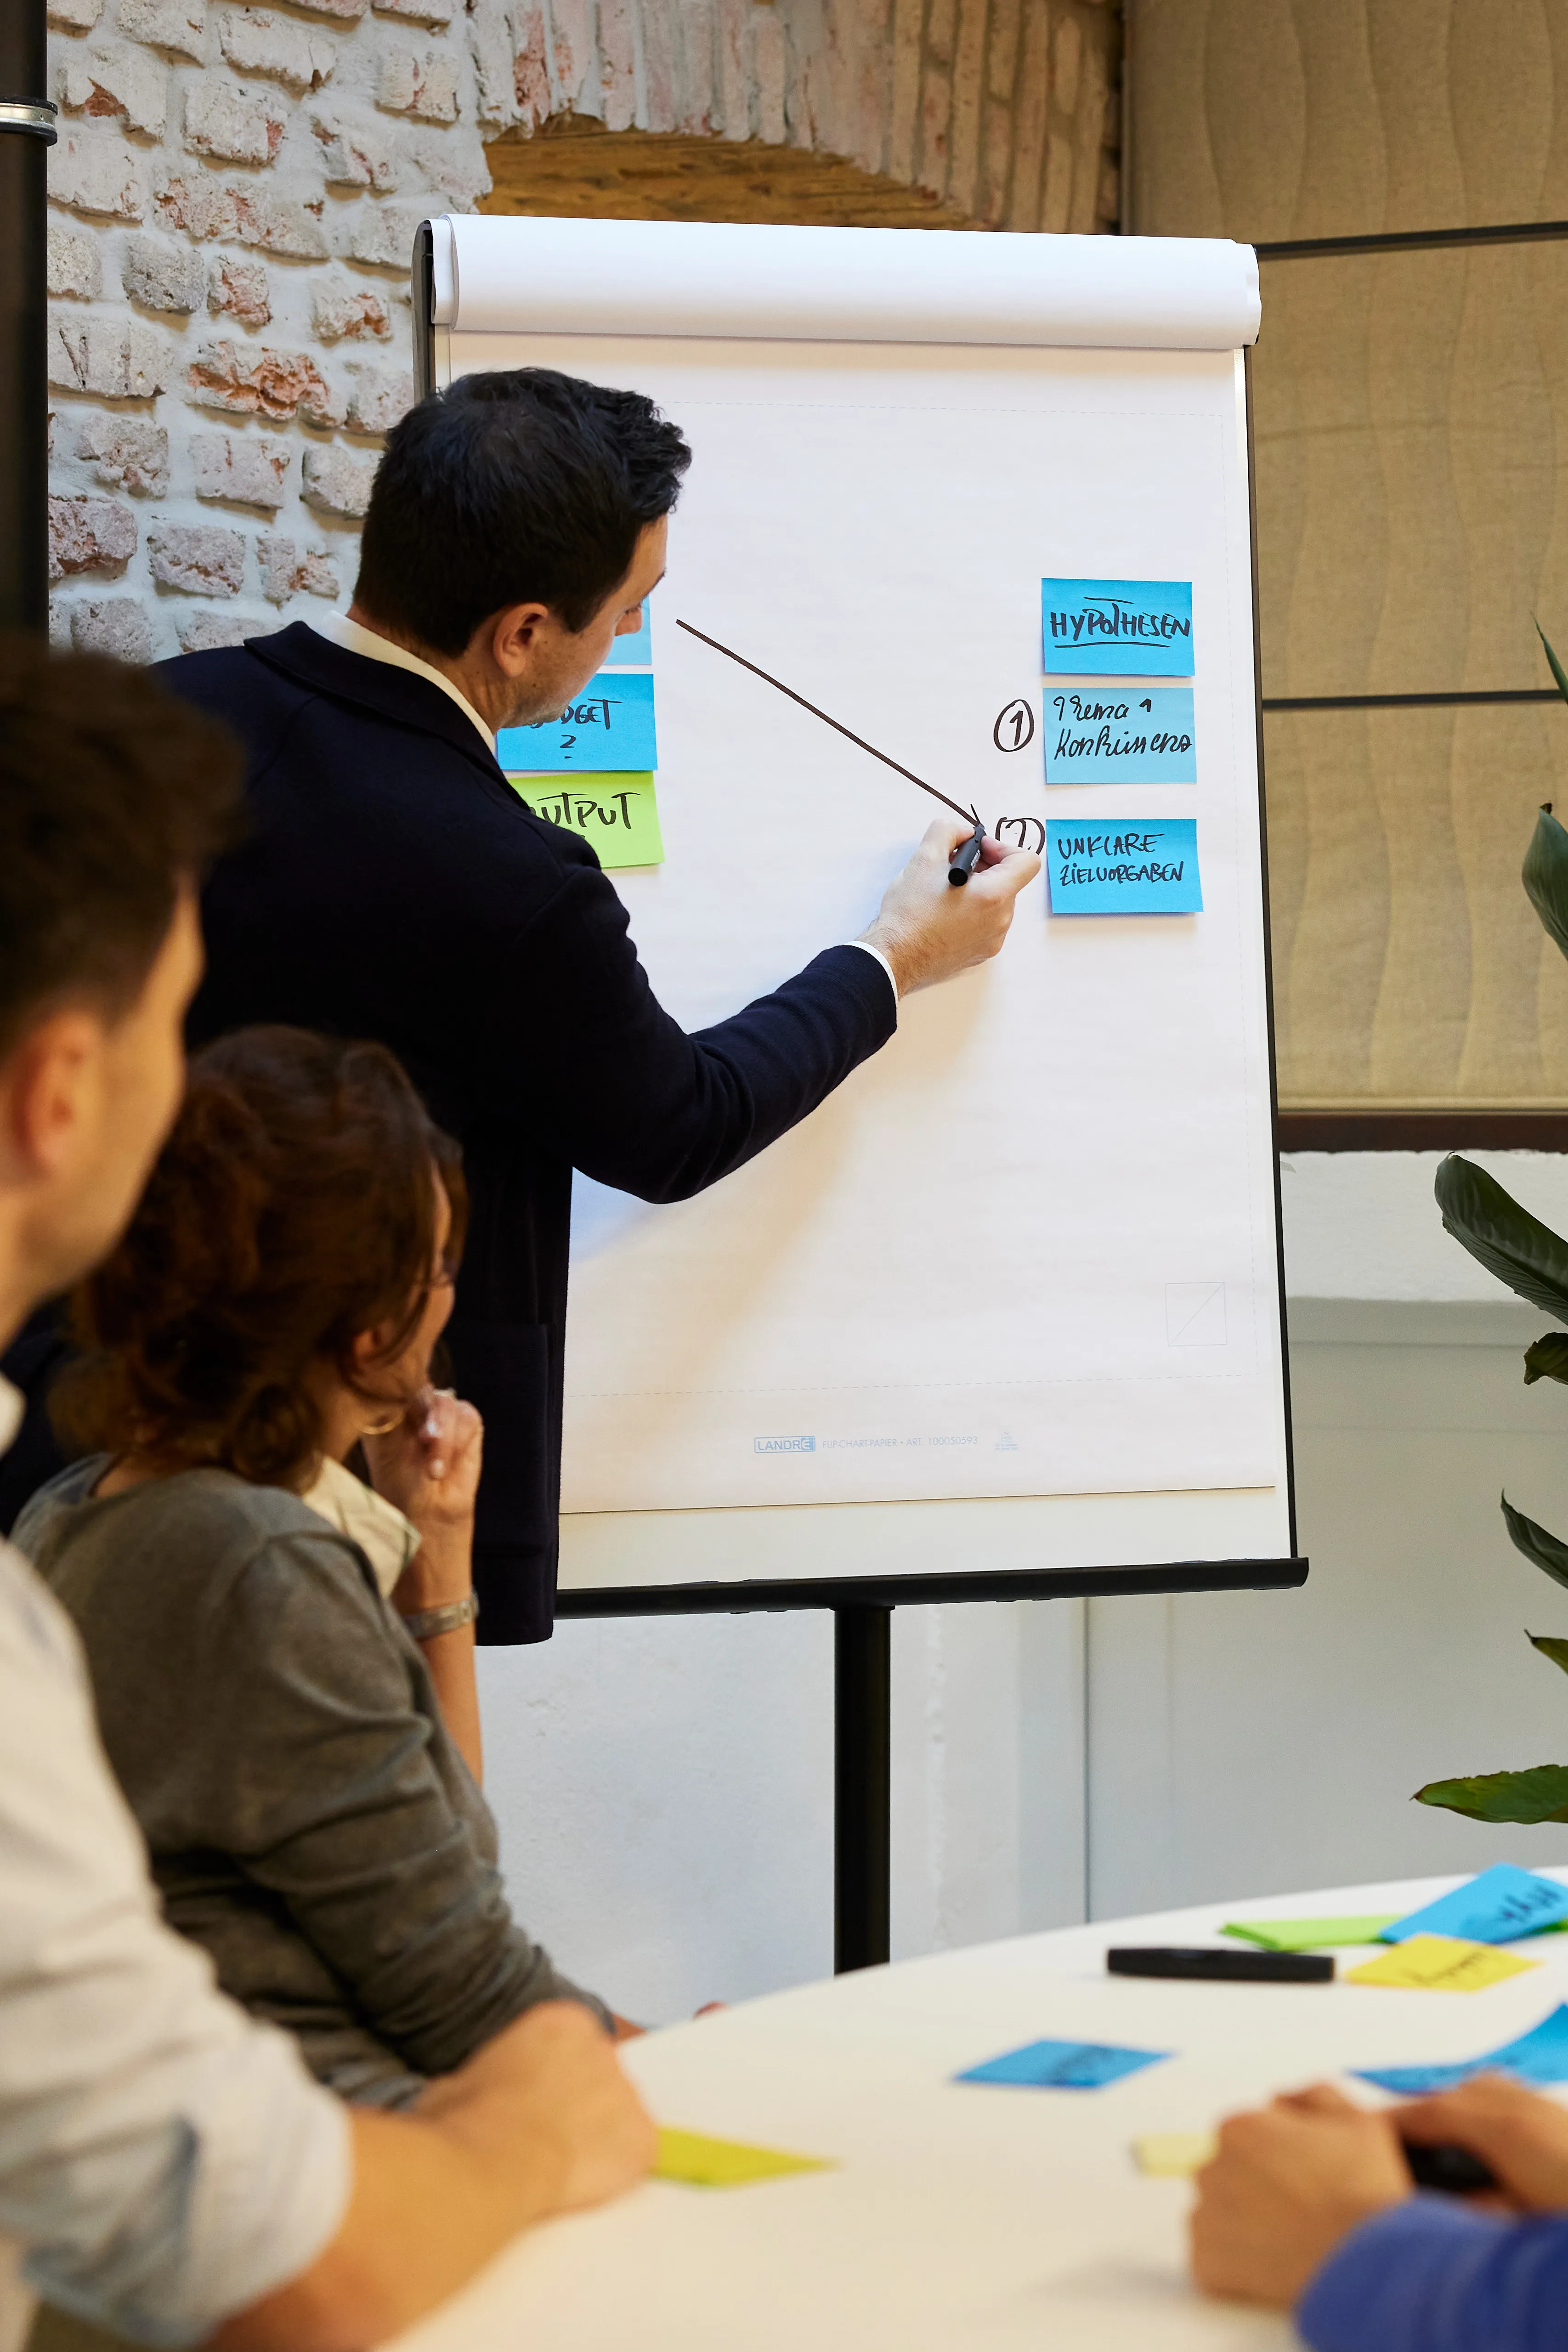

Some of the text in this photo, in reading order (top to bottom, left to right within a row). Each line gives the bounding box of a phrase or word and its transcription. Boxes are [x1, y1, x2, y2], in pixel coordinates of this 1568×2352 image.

[1049, 597, 1190, 642] HYPOTHESEN
[530, 792, 641, 829] UTPUT
[928, 1436, 978, 1446] 100050593
